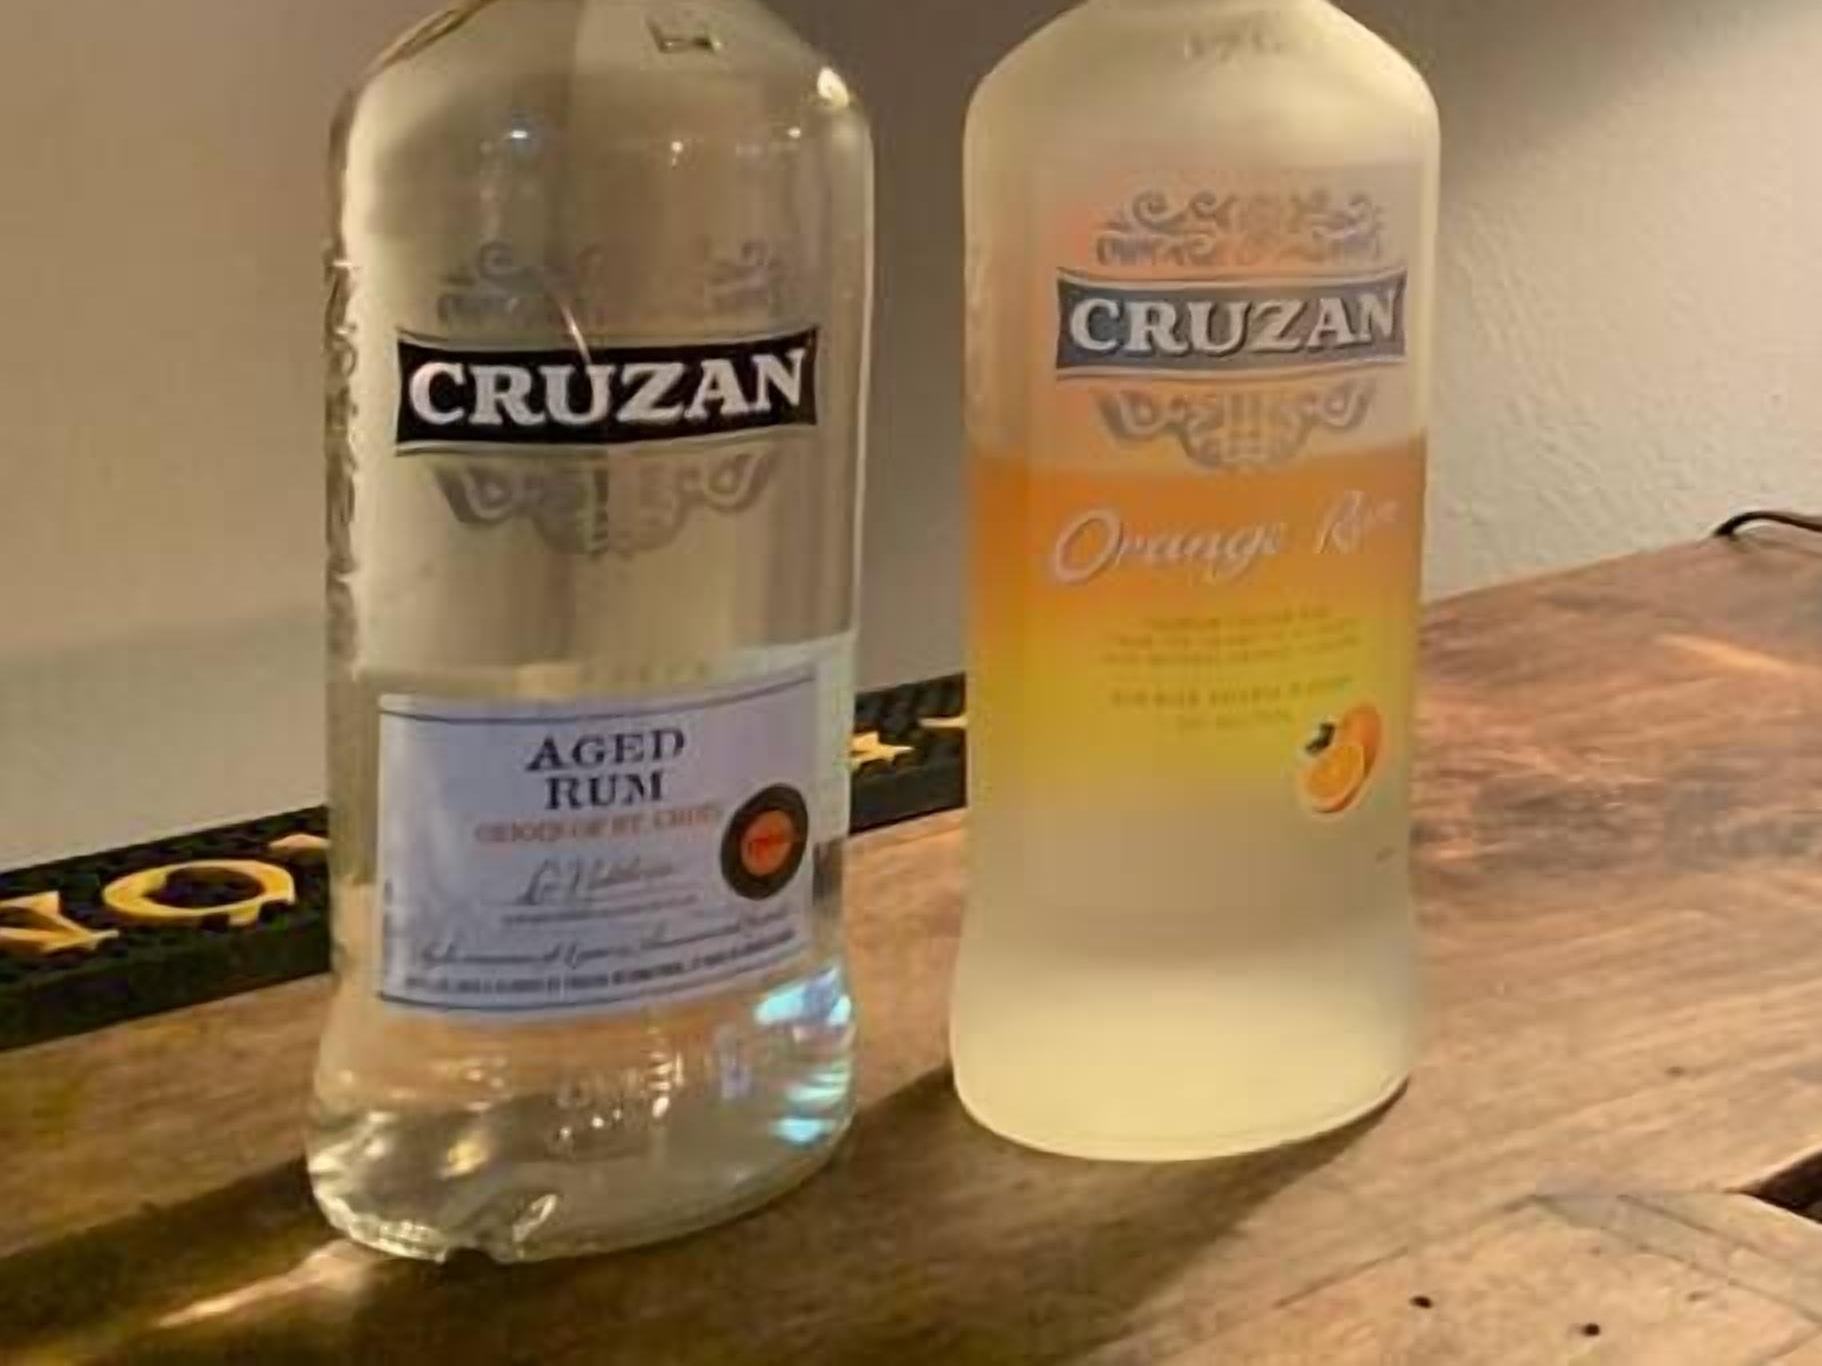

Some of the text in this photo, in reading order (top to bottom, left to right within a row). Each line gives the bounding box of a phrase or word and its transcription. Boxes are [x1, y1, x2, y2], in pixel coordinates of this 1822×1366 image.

[1069, 288, 1397, 355] CRUZAN
[408, 348, 806, 426] CRUZAN
[1052, 508, 1285, 586] Orange
[525, 728, 686, 772] AGED
[544, 769, 664, 811] RUM
